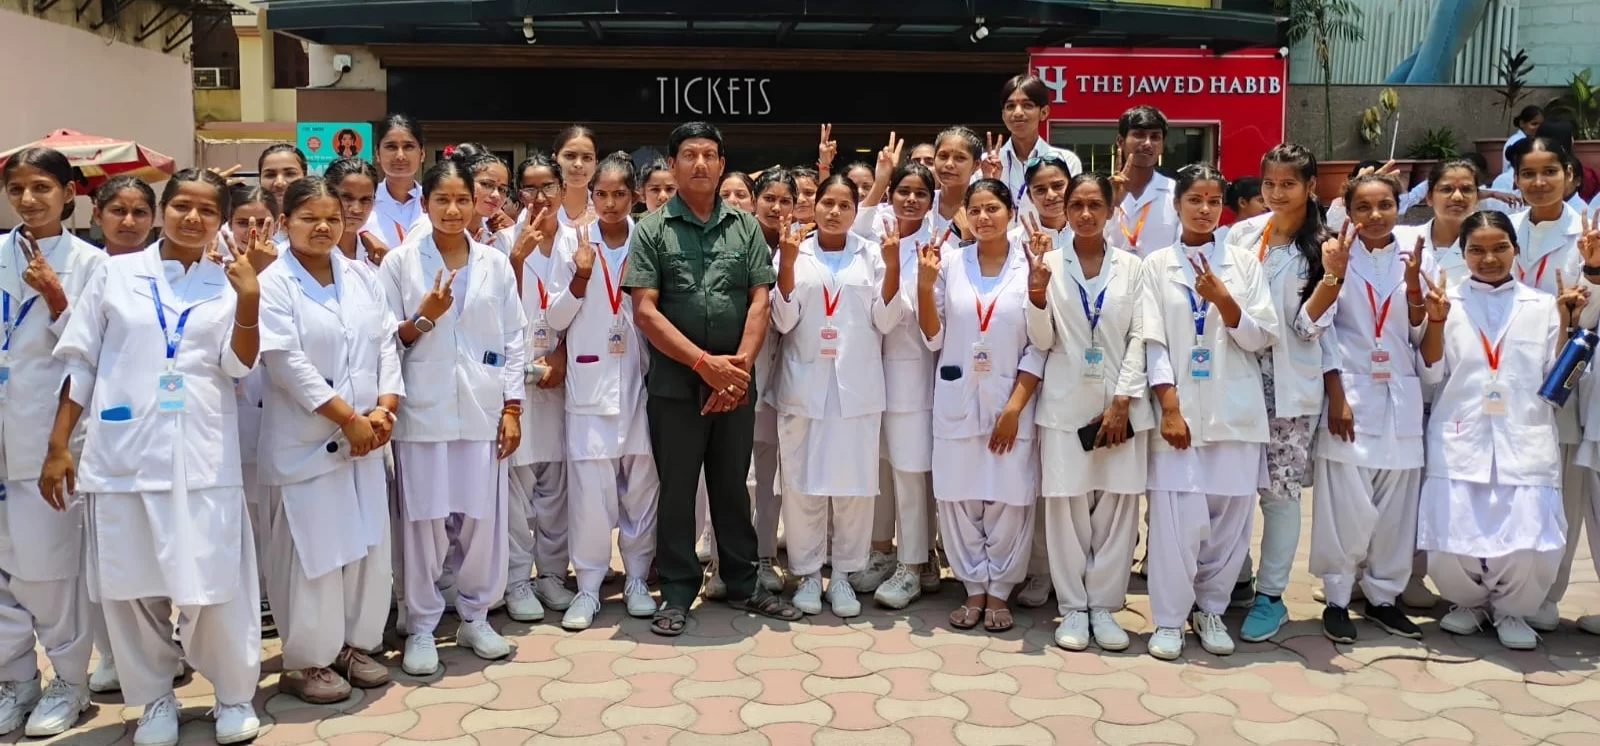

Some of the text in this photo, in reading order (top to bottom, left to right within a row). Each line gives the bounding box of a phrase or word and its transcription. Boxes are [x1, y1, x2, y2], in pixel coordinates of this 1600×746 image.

[656, 77, 771, 115] TICKETS
[1075, 75, 1281, 98] THE JAWED HABIB
